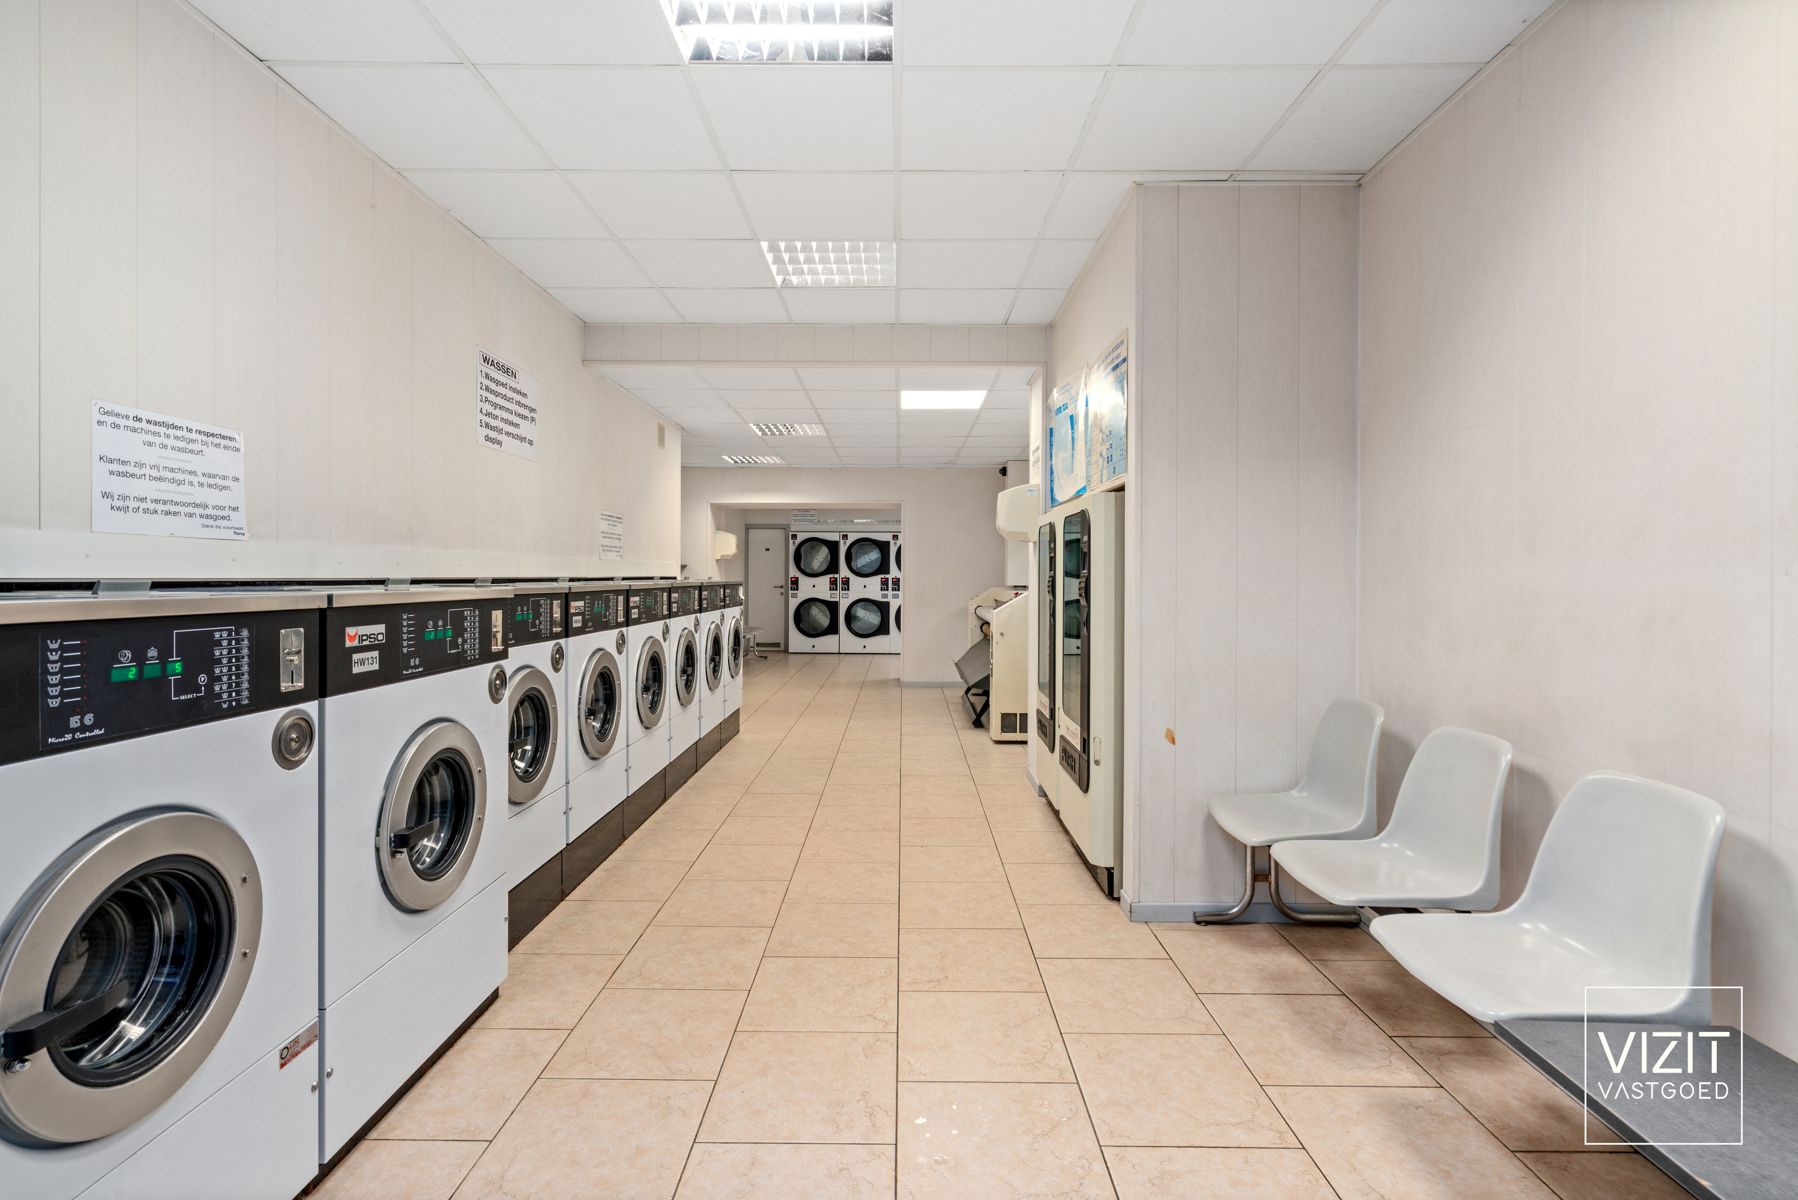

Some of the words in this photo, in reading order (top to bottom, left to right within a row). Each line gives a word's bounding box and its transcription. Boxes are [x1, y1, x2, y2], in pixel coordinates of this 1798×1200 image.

[481, 353, 517, 380] WASSEN
[508, 382, 528, 399] insteken
[514, 397, 537, 414] inbrengen
[98, 406, 131, 420] Gelieve
[132, 414, 143, 423] de
[145, 418, 184, 432] wastijden
[186, 425, 193, 433] te
[499, 414, 520, 429] insteken
[513, 409, 530, 422] kiezen
[529, 415, 537, 426] (P)
[96, 419, 107, 427] en
[110, 421, 121, 430] de
[123, 425, 162, 438] machines
[163, 431, 171, 440] te
[172, 433, 199, 445] ledigen
[201, 439, 209, 449] bij
[210, 440, 221, 450] het
[222, 443, 241, 453] einde
[484, 433, 503, 448] display
[503, 429, 527, 444] verschijnt
[527, 438, 533, 447] op
[142, 440, 156, 448] van
[158, 441, 168, 450] de
[170, 445, 206, 457] wasbeurt.
[98, 454, 132, 467] Klanten
[133, 460, 147, 471] zijn
[148, 463, 161, 473] vrij
[162, 465, 200, 478] machines,
[201, 471, 230, 481] waarvan
[231, 475, 240, 483] de
[108, 469, 147, 481] wasbeurt
[148, 473, 186, 487] beëindigd
[187, 480, 196, 488] is,
[206, 481, 233, 492] ledigen.
[100, 490, 115, 502] Wij
[116, 493, 131, 503] zijn
[132, 495, 148, 504] niet
[149, 497, 210, 511] verantwoordelijk
[211, 504, 227, 512] voor
[228, 505, 240, 513] het
[110, 503, 130, 515] kwijt
[131, 505, 140, 514] of
[142, 507, 159, 515] stuk
[160, 508, 182, 517] raken
[183, 511, 197, 519] van
[198, 513, 233, 522] wasgoed.
[358, 632, 385, 645] IPSO
[175, 662, 182, 673] 5
[353, 655, 378, 668] HW131
[127, 667, 136, 679] 2
[74, 728, 105, 739] Controlled
